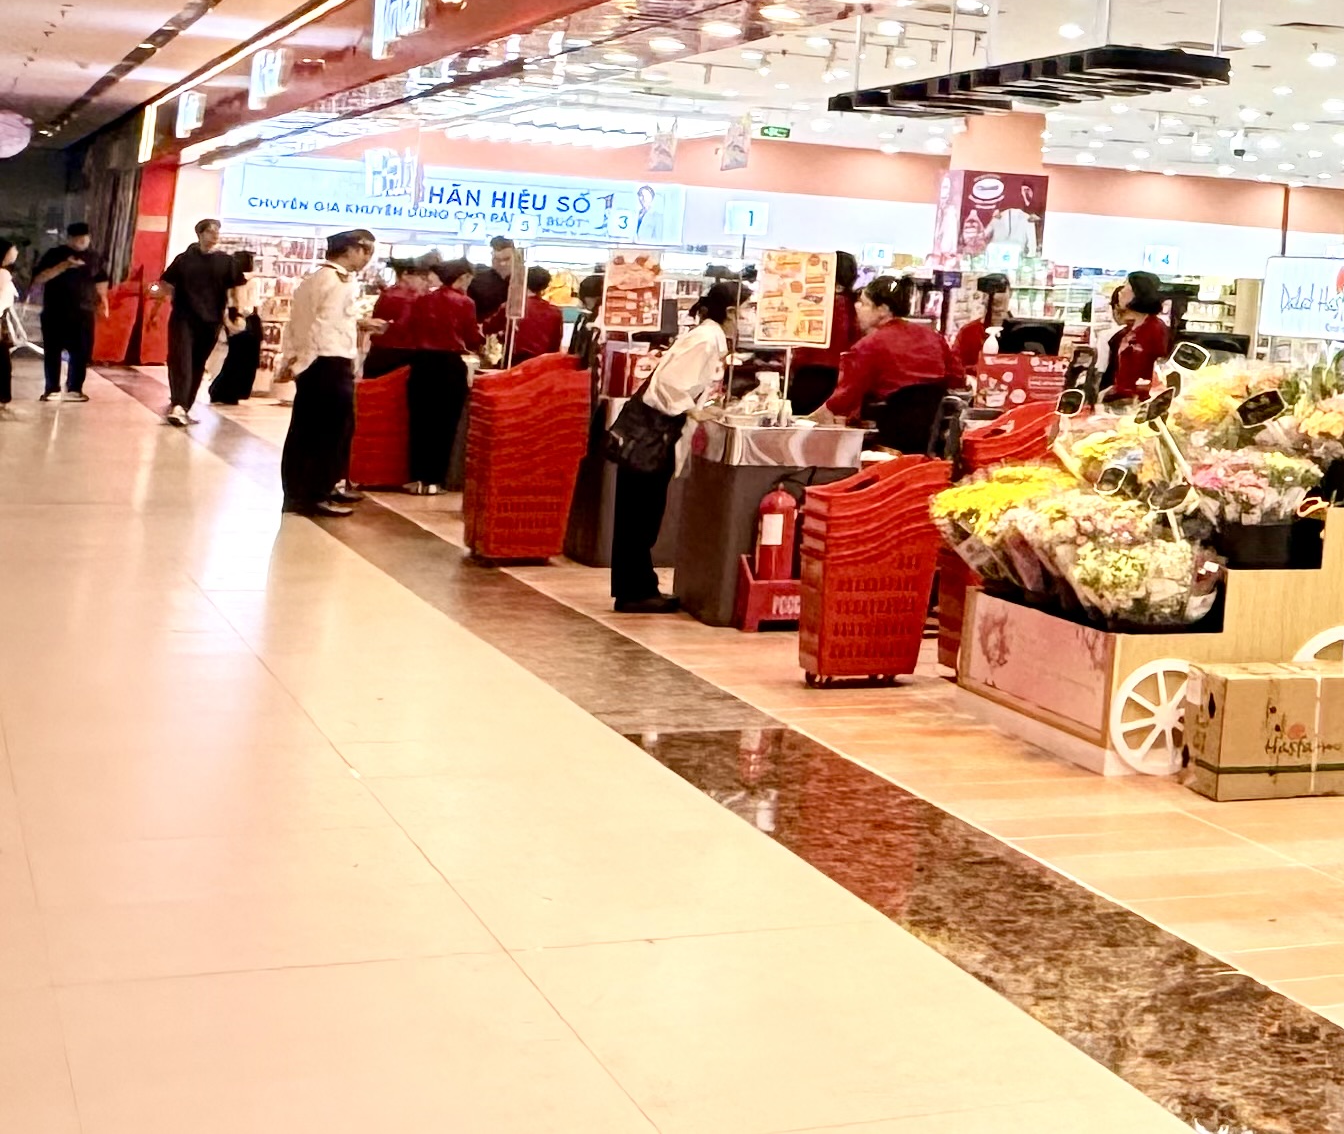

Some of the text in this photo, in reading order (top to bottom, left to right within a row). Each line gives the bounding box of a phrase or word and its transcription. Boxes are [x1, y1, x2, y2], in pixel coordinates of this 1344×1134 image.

[429, 184, 481, 207] HÃN
[491, 189, 547, 215] HIỆU
[556, 192, 591, 214] SỐ
[618, 216, 628, 229] 3
